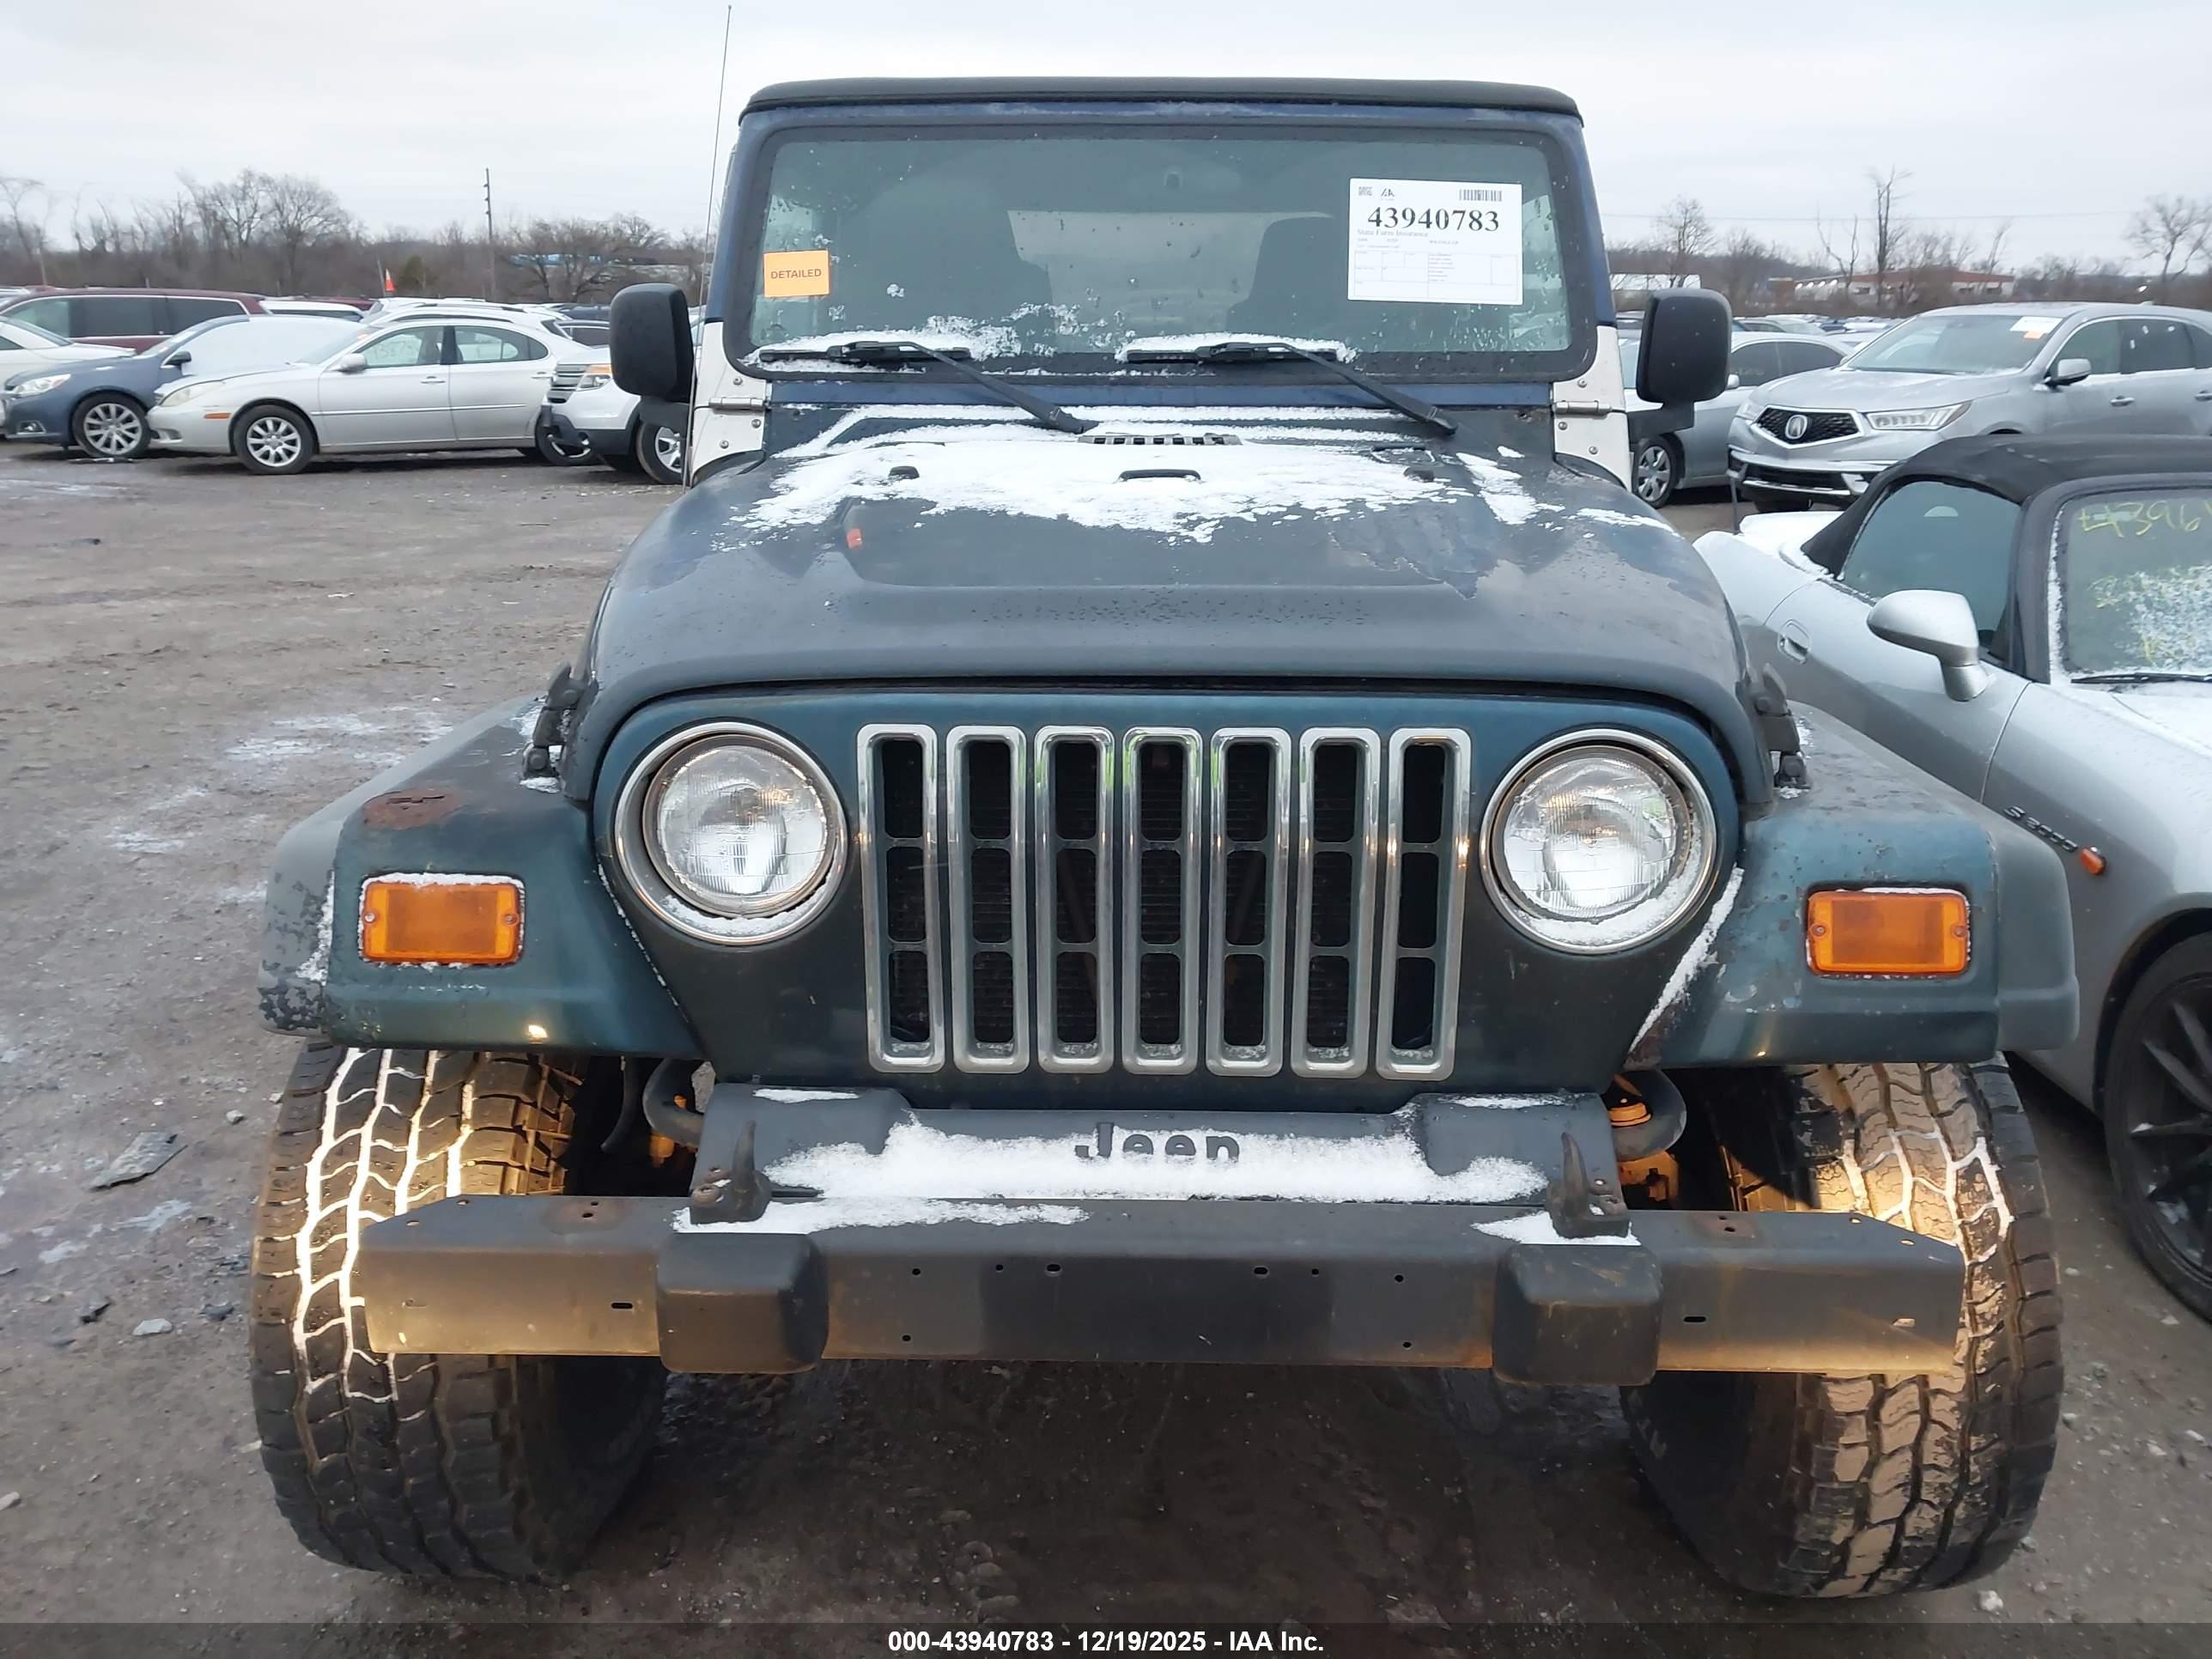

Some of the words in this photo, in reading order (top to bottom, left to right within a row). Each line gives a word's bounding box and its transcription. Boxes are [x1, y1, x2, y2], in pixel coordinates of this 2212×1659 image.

[1367, 206, 1499, 232] 43940783
[770, 268, 822, 280] DETAILED
[2077, 500, 2212, 538] 4396
